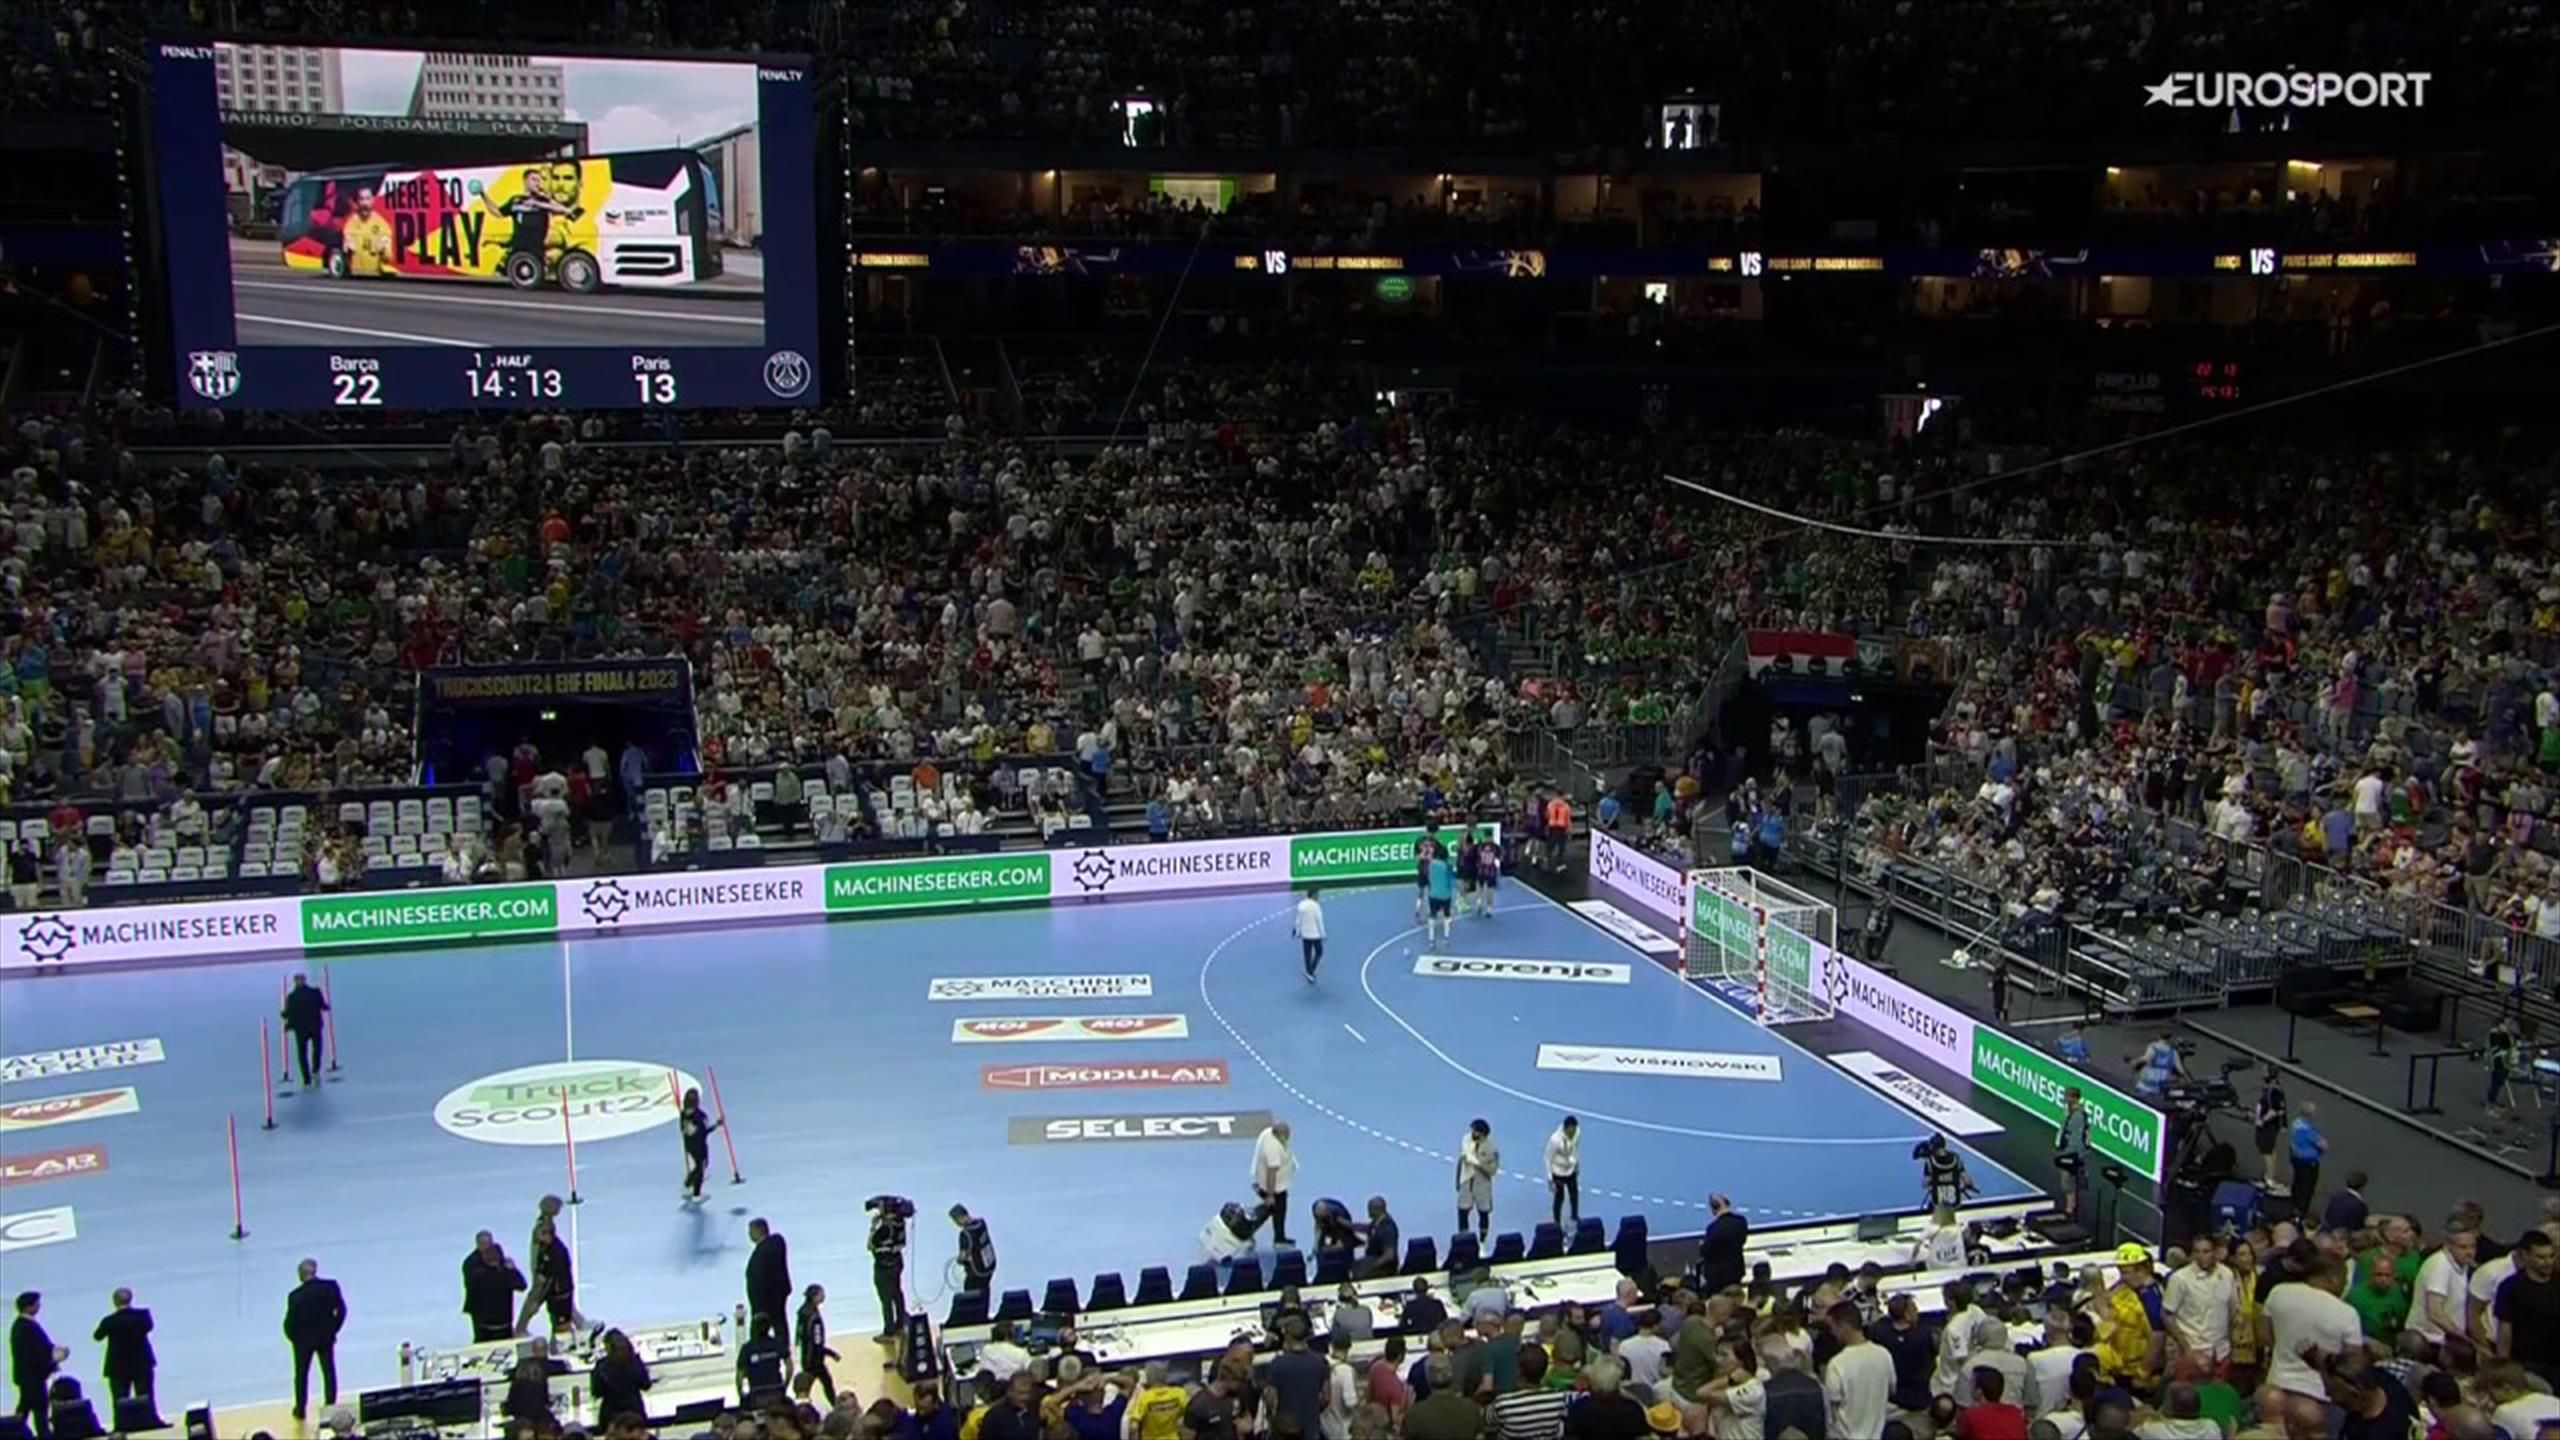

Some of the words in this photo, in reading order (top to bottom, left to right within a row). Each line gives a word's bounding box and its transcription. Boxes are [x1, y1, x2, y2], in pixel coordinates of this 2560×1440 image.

[161, 45, 214, 58] PENALTY
[759, 69, 803, 82] PENALTY
[491, 122, 559, 134] PLATZ
[385, 178, 429, 209] HERE
[438, 177, 463, 207] TO
[394, 211, 485, 266] PLAY
[1265, 250, 1286, 274] VS
[1740, 252, 1762, 276] VS
[2250, 249, 2275, 275] VS
[330, 355, 379, 372] Barça
[632, 355, 671, 370] Paris
[333, 375, 382, 405] 22
[465, 369, 563, 398] 14:13
[634, 374, 677, 403] 13
[434, 674, 551, 697] TRUCKSCOUT24
[554, 673, 582, 691] EHF
[584, 671, 636, 692] FINAL4
[638, 669, 678, 688] 2023
[1119, 851, 1272, 878] MACHINESEEKER
[635, 880, 804, 909] MACHINESEEKER
[833, 867, 1045, 898] MACHINESEEKER.COM
[312, 896, 550, 931] MACHINESEEKER.COM
[81, 913, 278, 946] MACHINESEEKER
[1432, 959, 1613, 978] gorenje
[991, 978, 1147, 989] MASCHINEN
[1017, 984, 1123, 996] SUCHER
[973, 1021, 1029, 1031] MOL
[1090, 1019, 1145, 1029] MOL
[1851, 980, 1958, 1051] MACHINESEEKER
[1044, 1066, 1221, 1084] MODULAR
[500, 1078, 643, 1102] Truck
[11, 1099, 83, 1117] MOL
[1046, 1117, 1236, 1139] SELECT
